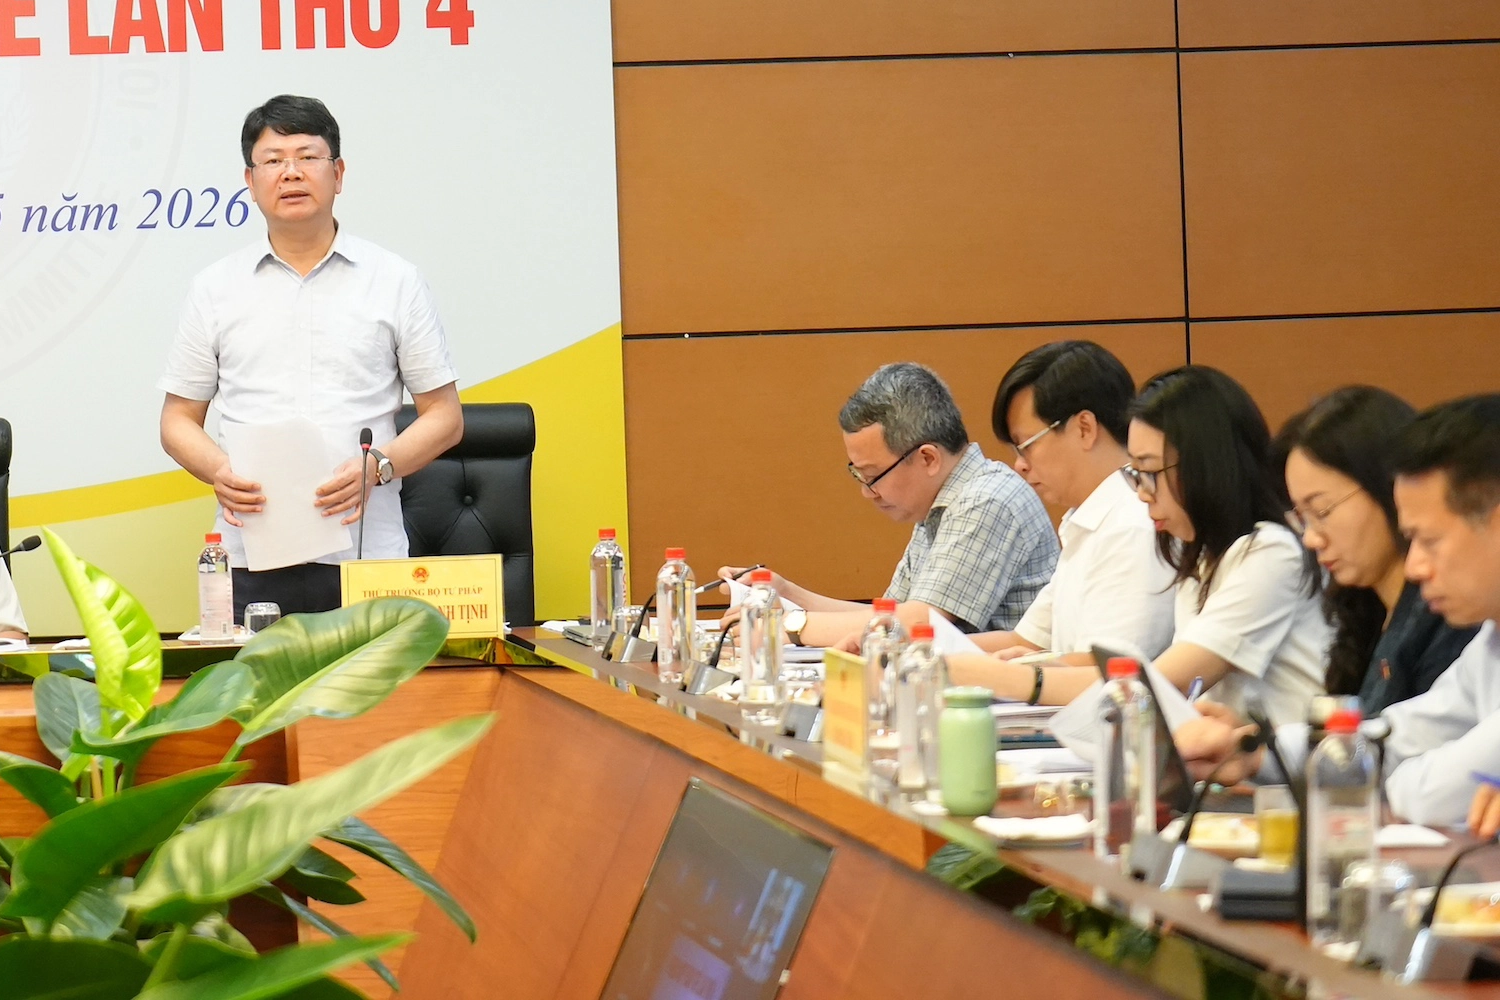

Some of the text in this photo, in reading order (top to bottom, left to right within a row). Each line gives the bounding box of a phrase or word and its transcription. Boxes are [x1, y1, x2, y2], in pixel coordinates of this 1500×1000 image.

[22, 191, 119, 233] năm
[135, 187, 250, 230] 2026
[458, 603, 488, 624] TỊNH
